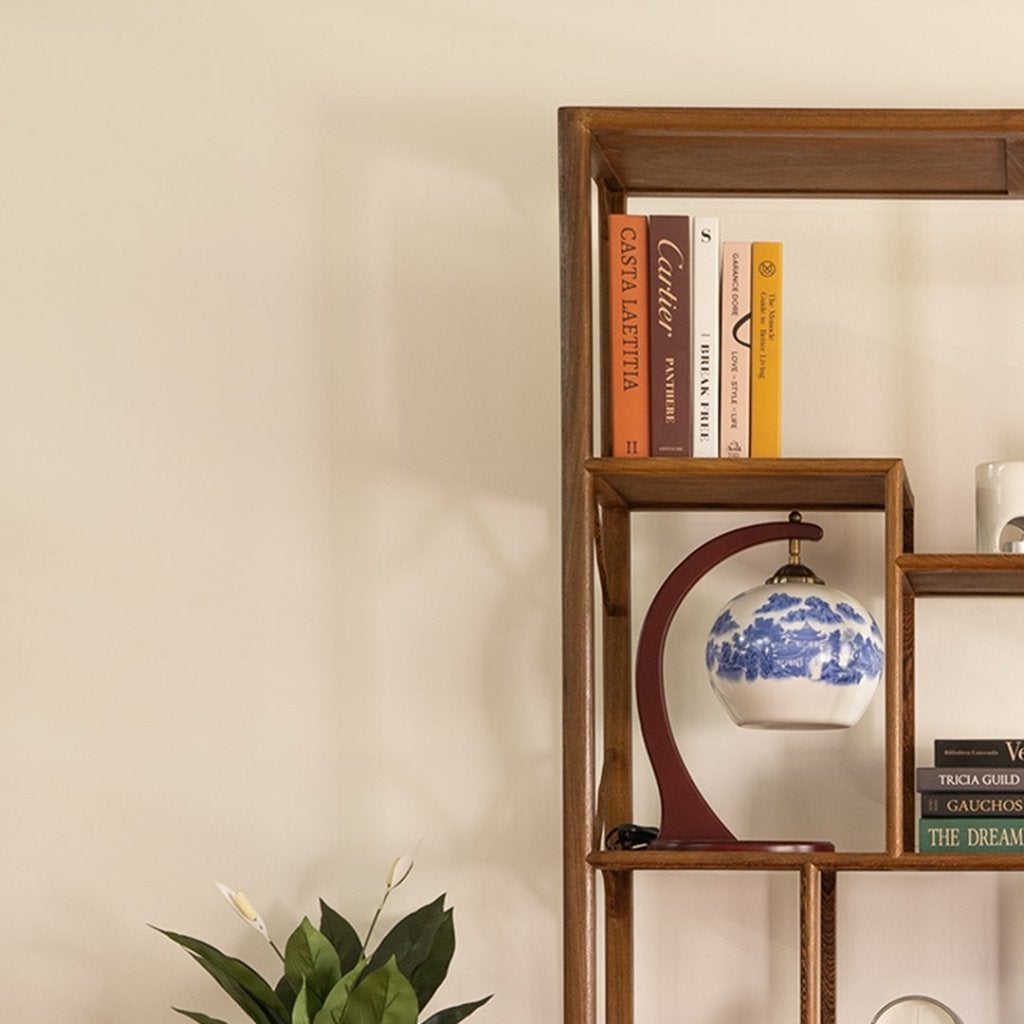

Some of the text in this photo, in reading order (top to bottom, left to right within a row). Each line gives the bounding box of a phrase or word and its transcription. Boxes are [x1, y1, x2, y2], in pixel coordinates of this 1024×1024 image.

[700, 228, 712, 244] S
[656, 238, 685, 338] Cartier
[620, 226, 639, 392] CASTA LAETITIA
[767, 310, 776, 341] Monocle
[757, 291, 768, 380] Guide to Better Living
[665, 357, 675, 424] PANTHERE
[700, 344, 711, 397] BREAK
[730, 350, 739, 430] LOVE STYLE LIFE
[700, 402, 711, 443] FREE
[626, 440, 638, 455] II
[939, 774, 1020, 786] TRICIA GUILD
[946, 799, 1023, 812] GAUCHOS
[928, 828, 960, 847] THE
